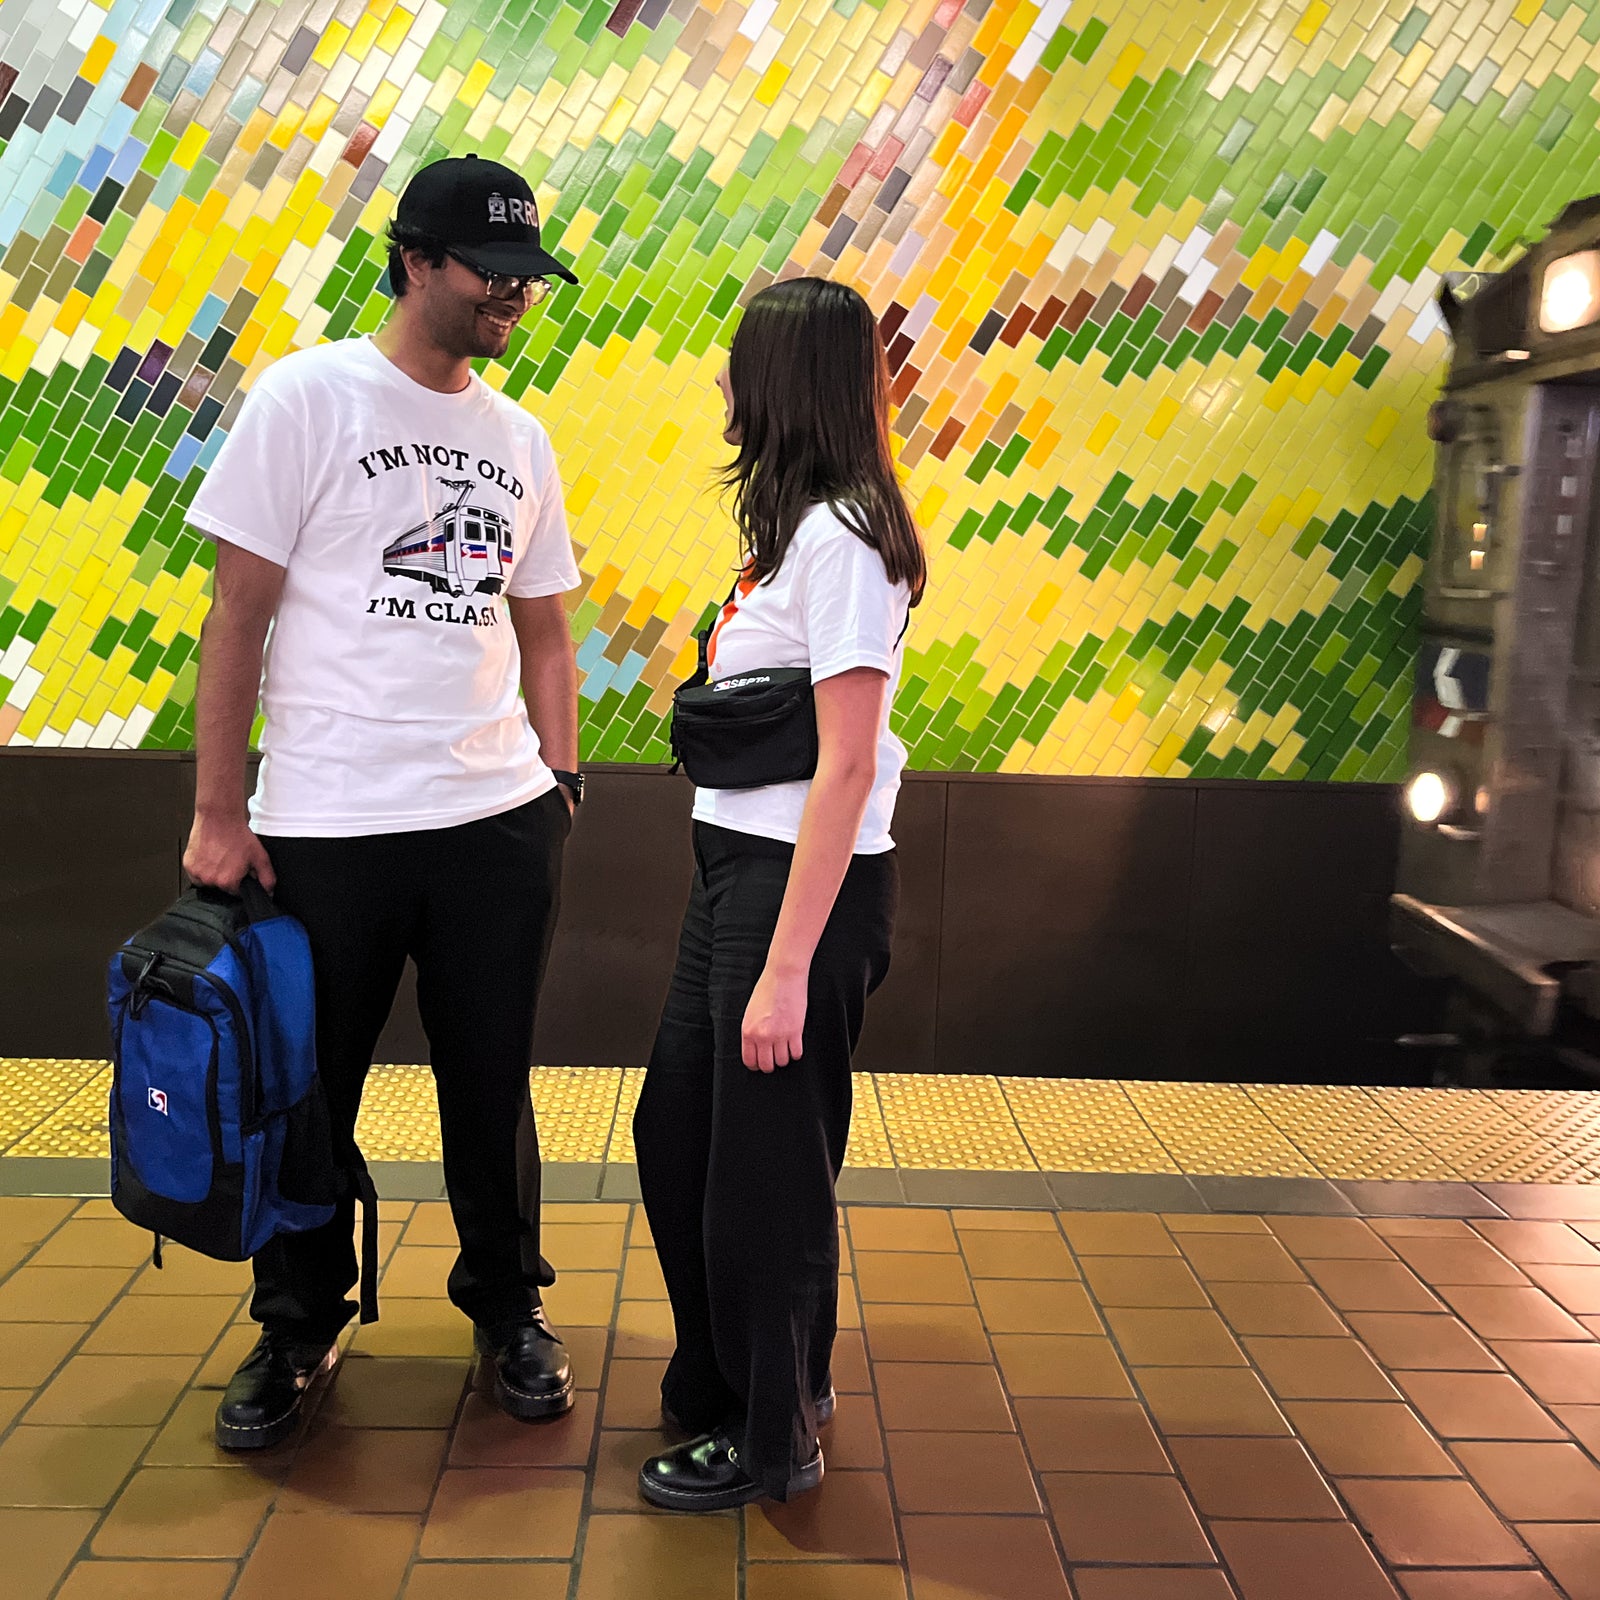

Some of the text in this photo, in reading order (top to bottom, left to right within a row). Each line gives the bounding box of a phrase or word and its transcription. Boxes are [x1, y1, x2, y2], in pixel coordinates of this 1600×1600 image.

[358, 443, 524, 500] I'M NOT OLD
[366, 597, 416, 619] I'M
[730, 676, 770, 689] SEPTA
